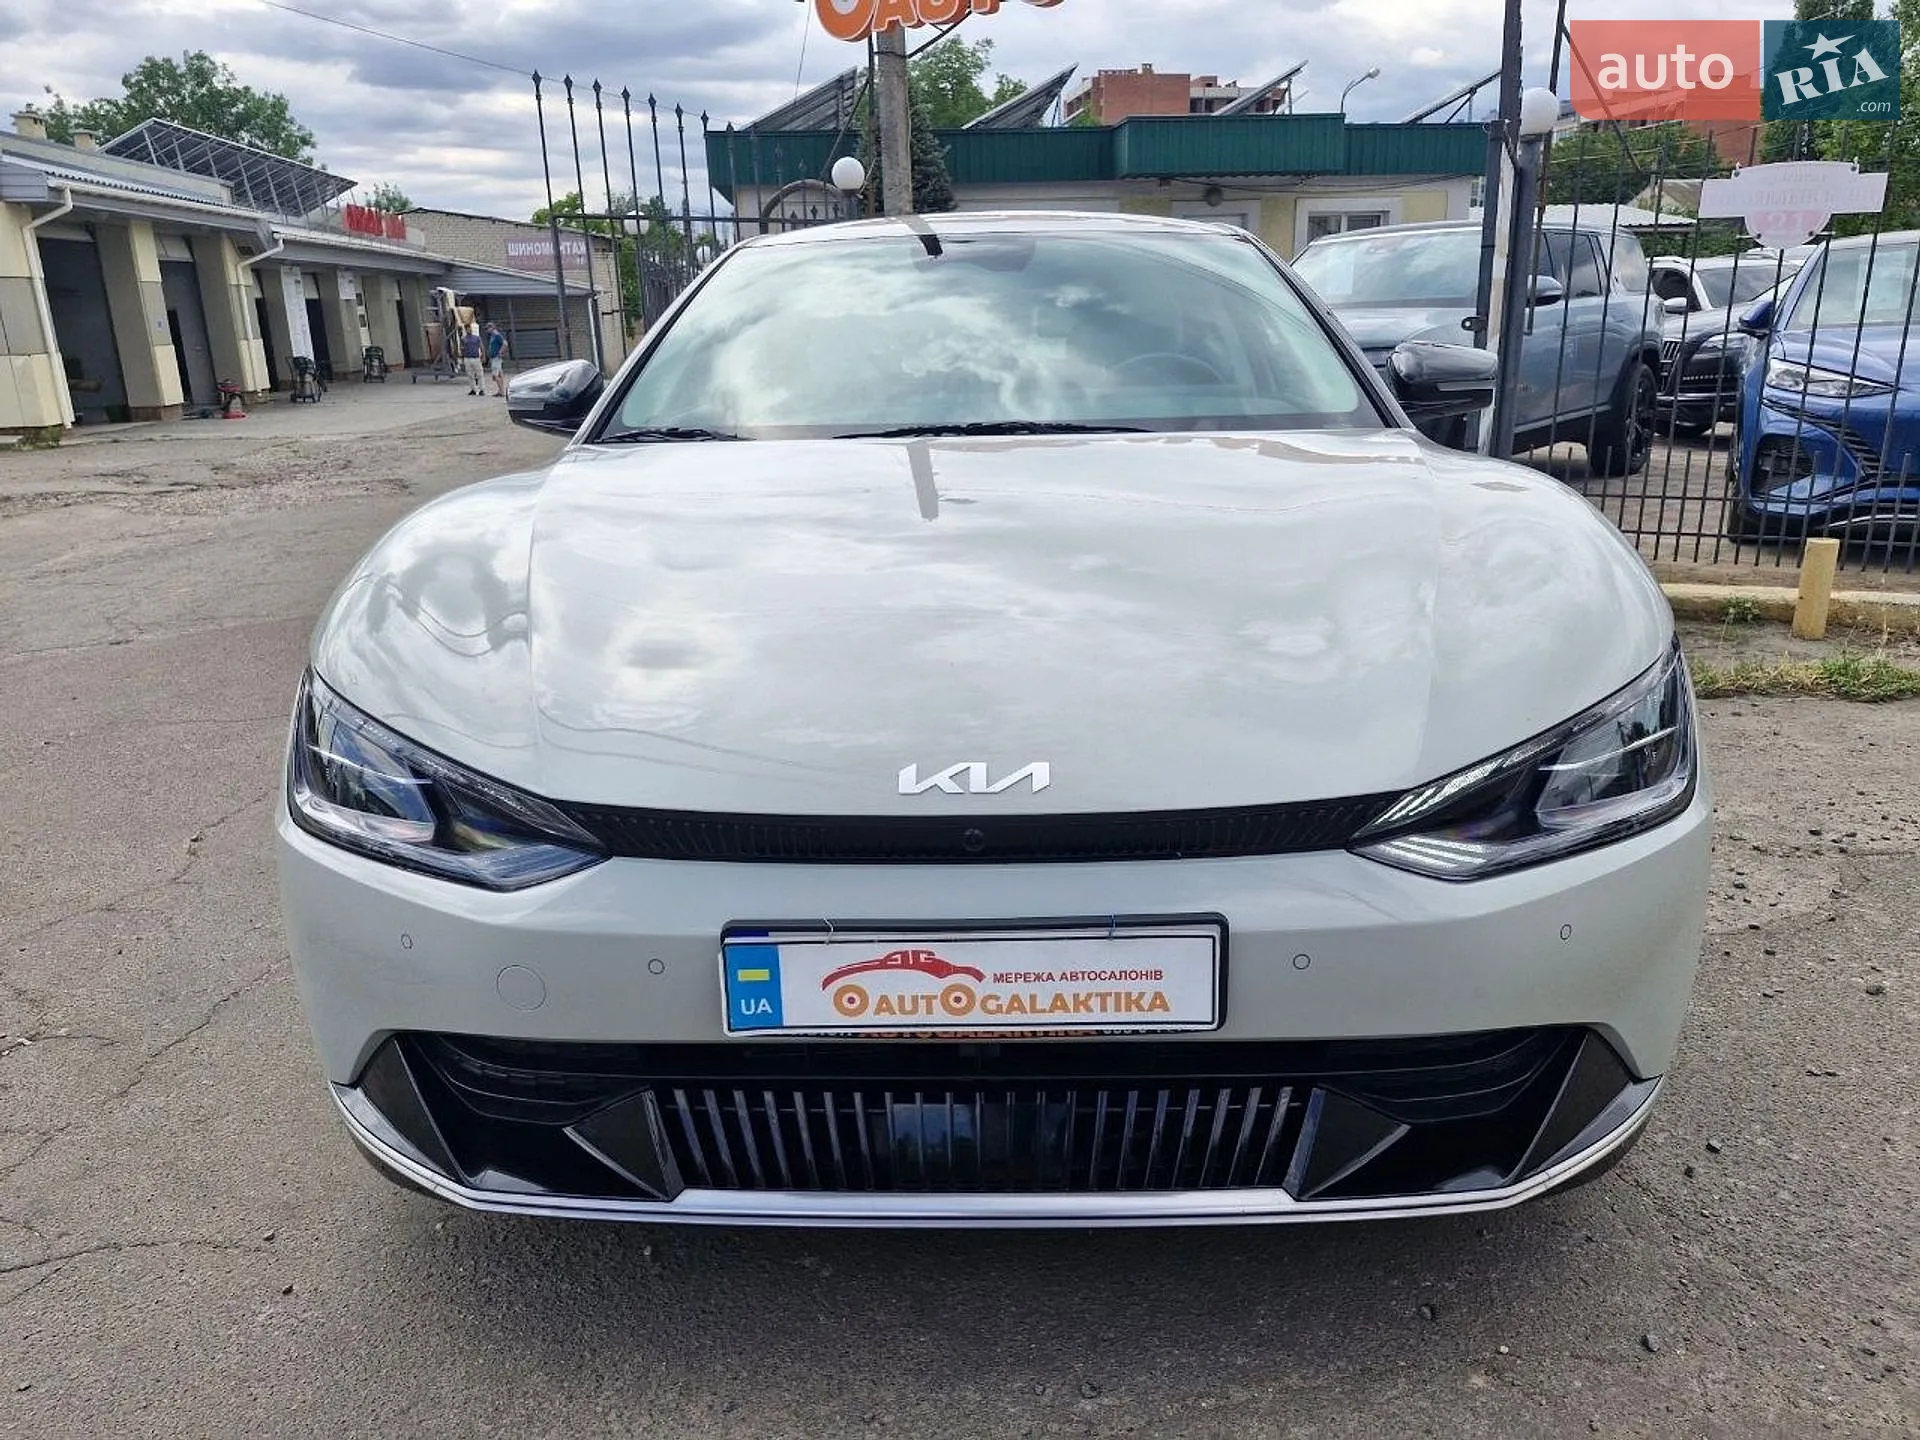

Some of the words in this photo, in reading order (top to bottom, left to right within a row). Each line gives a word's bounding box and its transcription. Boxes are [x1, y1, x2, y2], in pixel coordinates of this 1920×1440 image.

[898, 761, 1050, 795] KIA
[993, 971, 1056, 984] МЕРЕЖА
[1059, 969, 1164, 982] АВТОСАЛОНІВ
[741, 997, 773, 1015] UA
